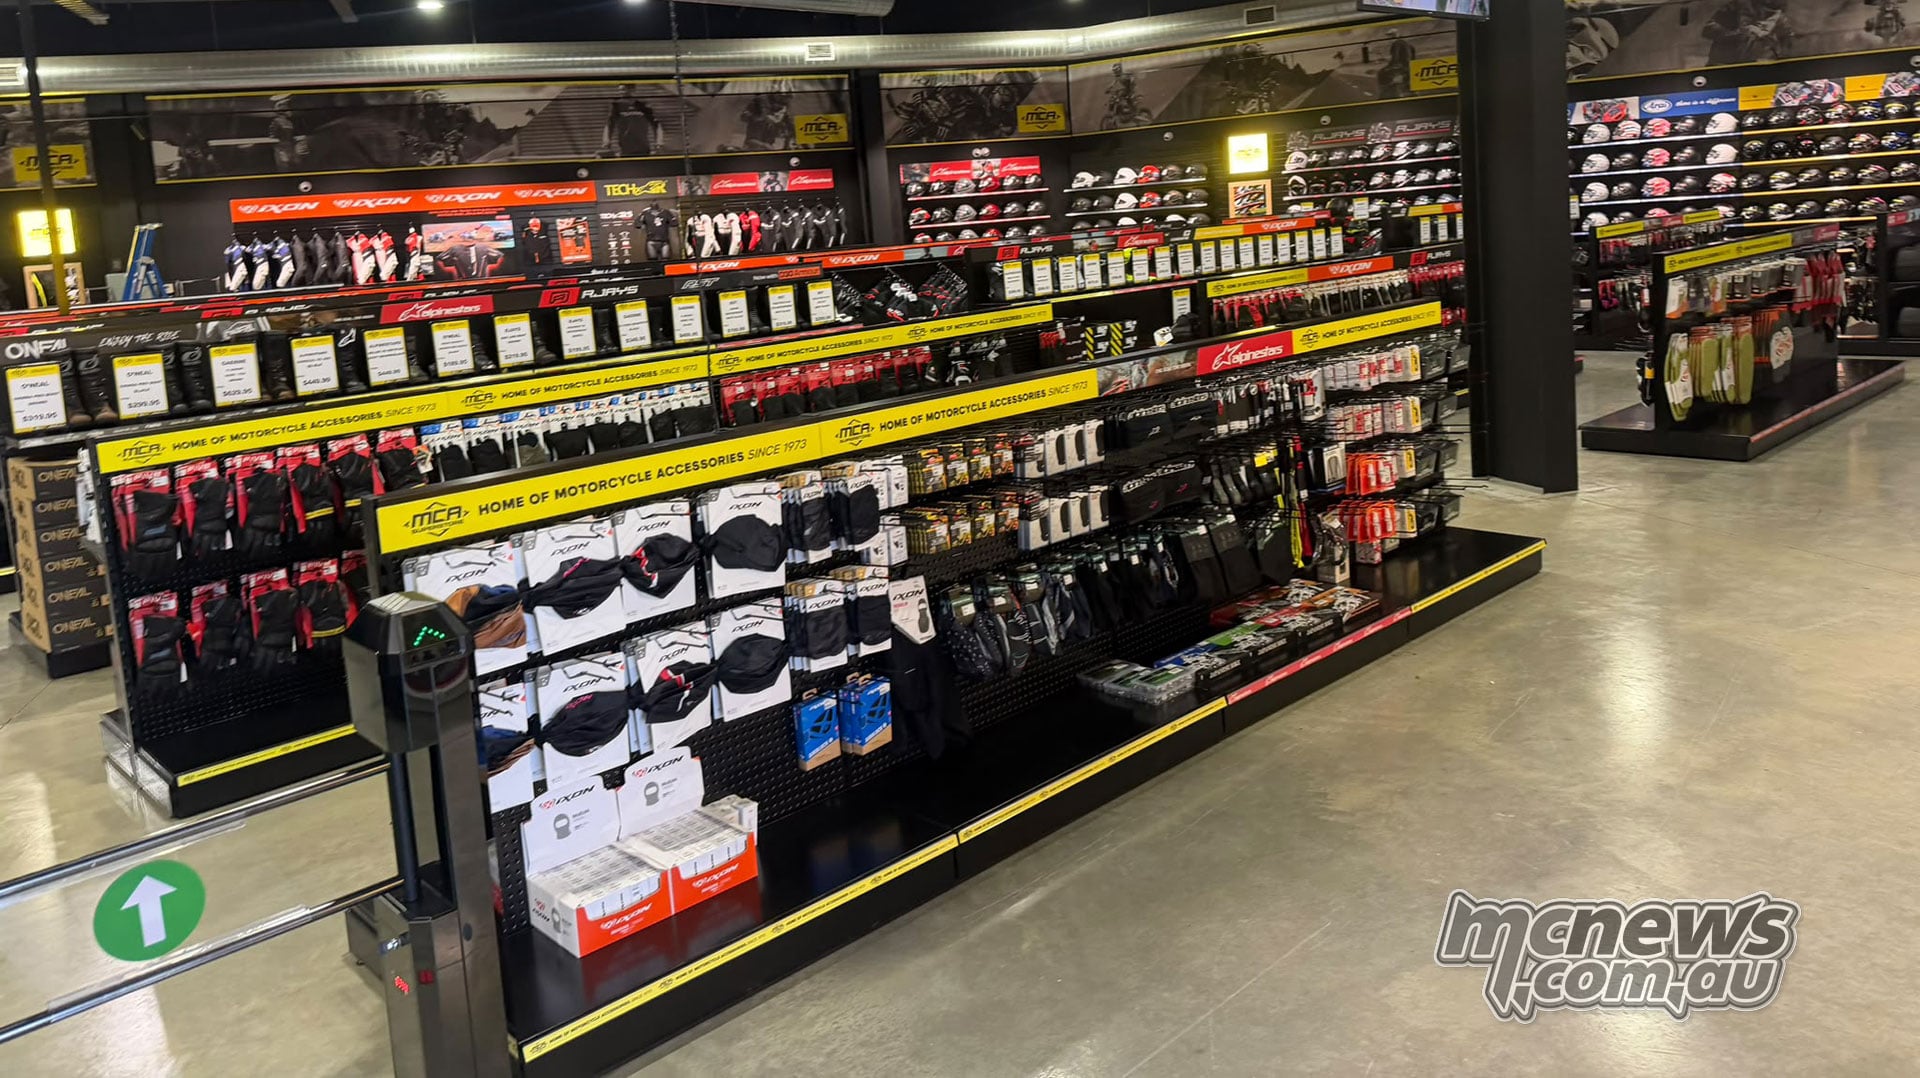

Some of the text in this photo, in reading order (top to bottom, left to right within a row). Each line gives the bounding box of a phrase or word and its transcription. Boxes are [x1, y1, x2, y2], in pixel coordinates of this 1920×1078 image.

[1025, 110, 1057, 121] MCA
[805, 121, 839, 132] MCA
[441, 192, 502, 204] IXON
[531, 186, 588, 199] IXON
[257, 202, 320, 214] IXON
[349, 197, 413, 209] IXON
[840, 253, 881, 265] IXON
[1340, 262, 1373, 274] IXON
[581, 285, 639, 299] RJAYS
[421, 304, 482, 319] alpinestars
[1346, 322, 1380, 334] MOTORCYCLE
[135, 332, 154, 343] THE
[746, 353, 765, 362] HOME
[767, 351, 776, 360] OF
[777, 345, 820, 358] MOTORCYCLE
[821, 339, 862, 352] ACCESSORIES
[1231, 345, 1284, 365] alpinestars
[464, 392, 493, 404] MCA
[501, 388, 528, 399] HOME
[530, 386, 541, 396] OF
[543, 378, 601, 393] MOTORCYCLE
[603, 370, 658, 384] ACCESSORIES
[840, 380, 1089, 437] MCA HOME OF MOTORCYCLE ACCESSORIES SINCE 1973
[122, 402, 438, 459] MCA HOME OF MOTORCYCLE ACCESSORIES SINCE 1973
[411, 438, 808, 529] MCA HOME OF MOTORCYCLE ACCESSORIES SINCE 1973
[849, 478, 873, 489] IXON
[728, 501, 763, 511] IXON
[637, 519, 671, 532] IXON
[550, 541, 590, 556] IXON
[445, 567, 490, 584] IXON
[859, 583, 887, 593] IXON
[893, 588, 924, 601] IXON
[808, 598, 841, 610] IXON
[731, 619, 764, 633] IXON
[658, 646, 689, 663] IXON
[562, 677, 602, 693] IXON
[647, 755, 684, 774] IXON
[555, 784, 596, 805] IXON
[706, 863, 739, 885] IXON
[616, 903, 652, 925] IXON
